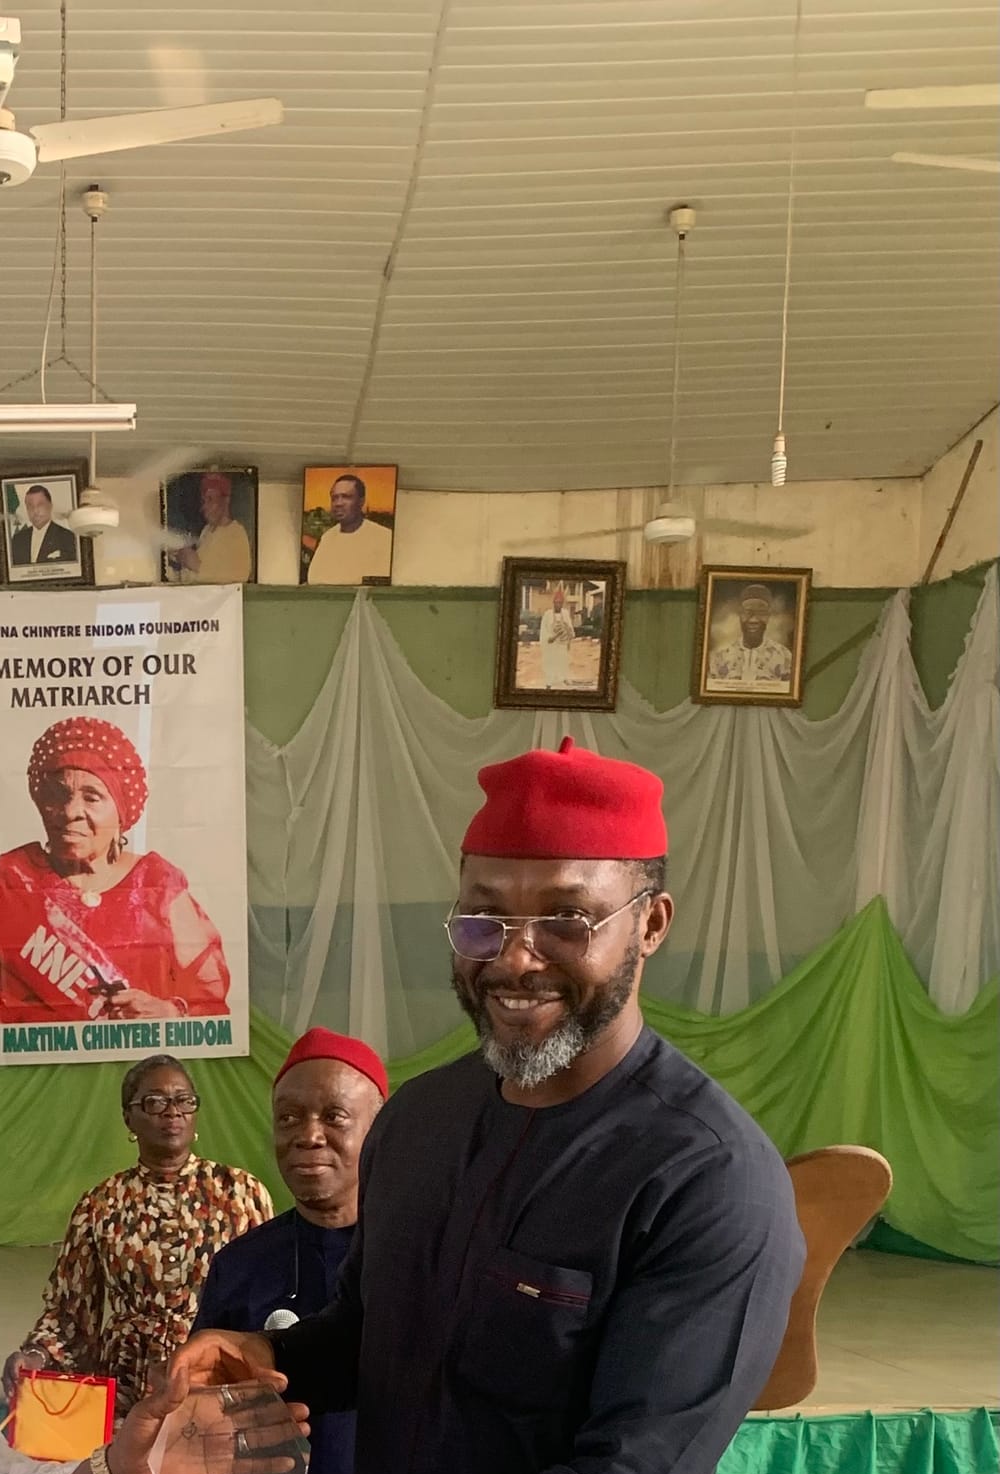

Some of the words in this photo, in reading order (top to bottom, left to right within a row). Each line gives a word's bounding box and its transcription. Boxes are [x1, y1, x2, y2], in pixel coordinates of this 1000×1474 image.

[22, 624, 81, 638] CHINYERE
[85, 623, 135, 637] ENIDOM
[139, 620, 220, 635] FOUNDATION
[102, 656, 134, 677] OF
[142, 654, 197, 676] OUR
[11, 684, 151, 708] MATRIARCH
[2, 1025, 78, 1052] MARTINA
[82, 1022, 161, 1050] CHINYERE
[165, 1019, 233, 1046] ENIDOM
